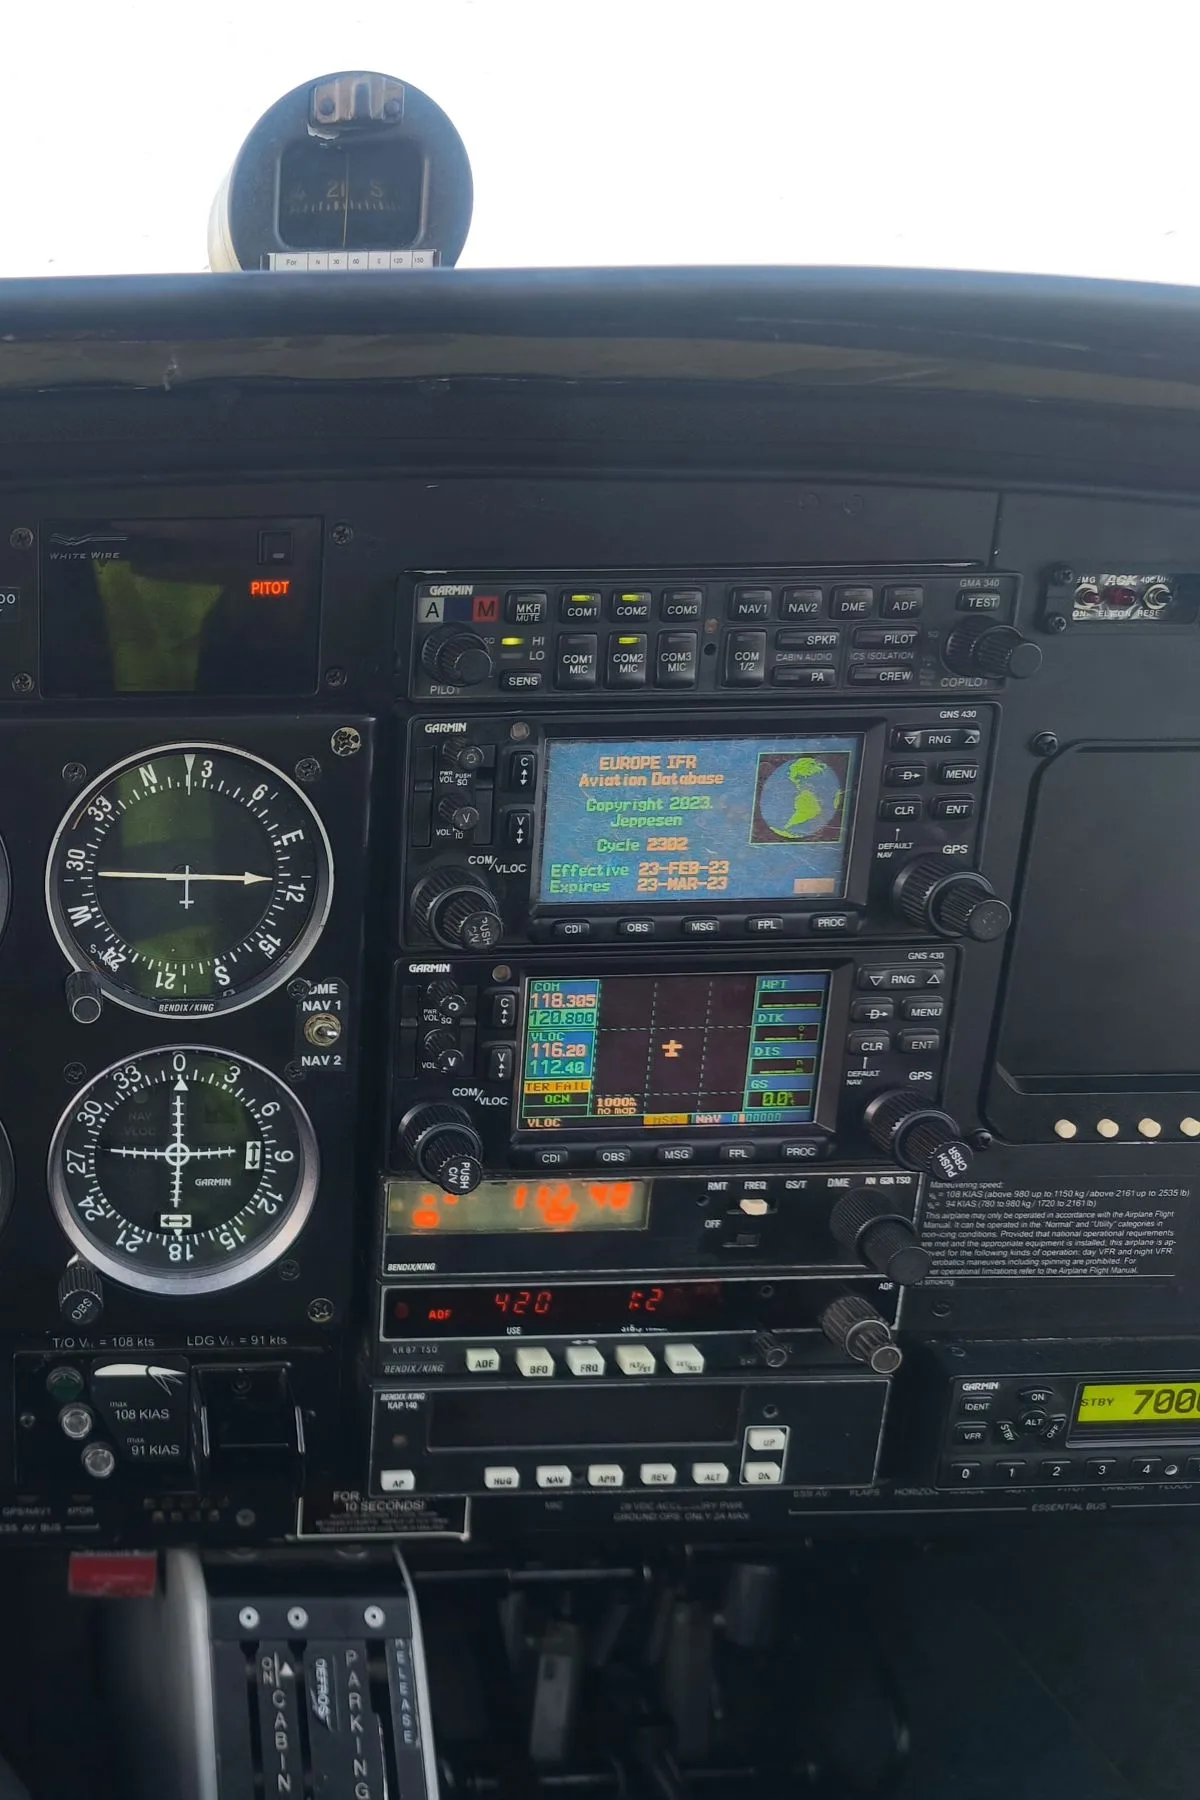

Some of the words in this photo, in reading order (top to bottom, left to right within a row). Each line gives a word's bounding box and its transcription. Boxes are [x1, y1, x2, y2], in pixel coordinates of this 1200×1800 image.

[251, 581, 289, 595] PITOT
[430, 585, 473, 596] GARMIN
[788, 603, 818, 613] NAV2
[841, 602, 866, 612] DME
[892, 601, 916, 611] ADF
[968, 598, 997, 608] TEST
[567, 607, 598, 617] COM1
[616, 606, 647, 616] COM2
[667, 605, 698, 615] COM3
[738, 604, 768, 614] NAV1
[532, 637, 544, 645] HI
[806, 635, 836, 645] SPKR
[884, 634, 916, 644] PILOT
[529, 651, 544, 660] LO
[508, 676, 538, 686] SENS
[879, 672, 912, 682] CREW
[961, 710, 976, 718] 430
[425, 723, 466, 733] GARMIN
[928, 736, 951, 744] RNG
[599, 757, 660, 770] EUROPE
[667, 755, 696, 769] IFR
[946, 770, 976, 778] MENU
[579, 773, 646, 788] Aviation
[652, 772, 725, 786] Database
[586, 798, 664, 812] Copyright
[946, 806, 967, 814] ENT
[895, 806, 914, 815] CLR
[611, 814, 682, 828] Jeppesen
[597, 839, 640, 853] Cycle
[647, 838, 688, 851] 2302
[943, 845, 968, 854] GPS
[550, 864, 629, 877] Effective
[638, 860, 729, 875] 23-FEB-23
[550, 880, 610, 894] Expires
[636, 877, 728, 892] 23-MAR-23
[627, 923, 648, 932] OBS
[691, 921, 713, 931] MSG
[757, 920, 776, 929] FPL
[818, 918, 845, 928] PROC
[564, 925, 582, 934] CDI
[409, 964, 450, 972] GARMIN
[302, 1001, 327, 1011] NAV
[335, 1000, 341, 1010] 1
[531, 993, 595, 1008] 118.305
[159, 1003, 214, 1012] BENDIX/KING
[530, 1011, 594, 1025] 120.800
[532, 1043, 586, 1057] 116.20
[754, 1046, 780, 1056] DIS
[301, 1056, 330, 1066] NAV
[335, 1055, 341, 1065] 2
[531, 1060, 584, 1074] 112.40
[526, 1082, 549, 1091] TER
[556, 1081, 588, 1091] FAIL
[528, 1118, 560, 1127] VLOC
[195, 1178, 231, 1186] GARMIN
[708, 1182, 728, 1190] RMT
[744, 1181, 767, 1190] FREQ
[785, 1180, 807, 1189] GS/T
[827, 1179, 849, 1187] DME
[495, 1292, 552, 1313] 420
[429, 1310, 450, 1319] ADF
[111, 1337, 133, 1347] 108
[136, 1337, 155, 1347] kts
[187, 1336, 217, 1346] LDG
[251, 1335, 266, 1345] 91
[269, 1335, 287, 1345] kts
[475, 1360, 493, 1368] ADF
[962, 1382, 999, 1391] GARMIN
[1081, 1398, 1115, 1406] STBY
[1133, 1389, 1200, 1414] 700
[115, 1410, 136, 1420] 108
[139, 1409, 168, 1420] KIAS
